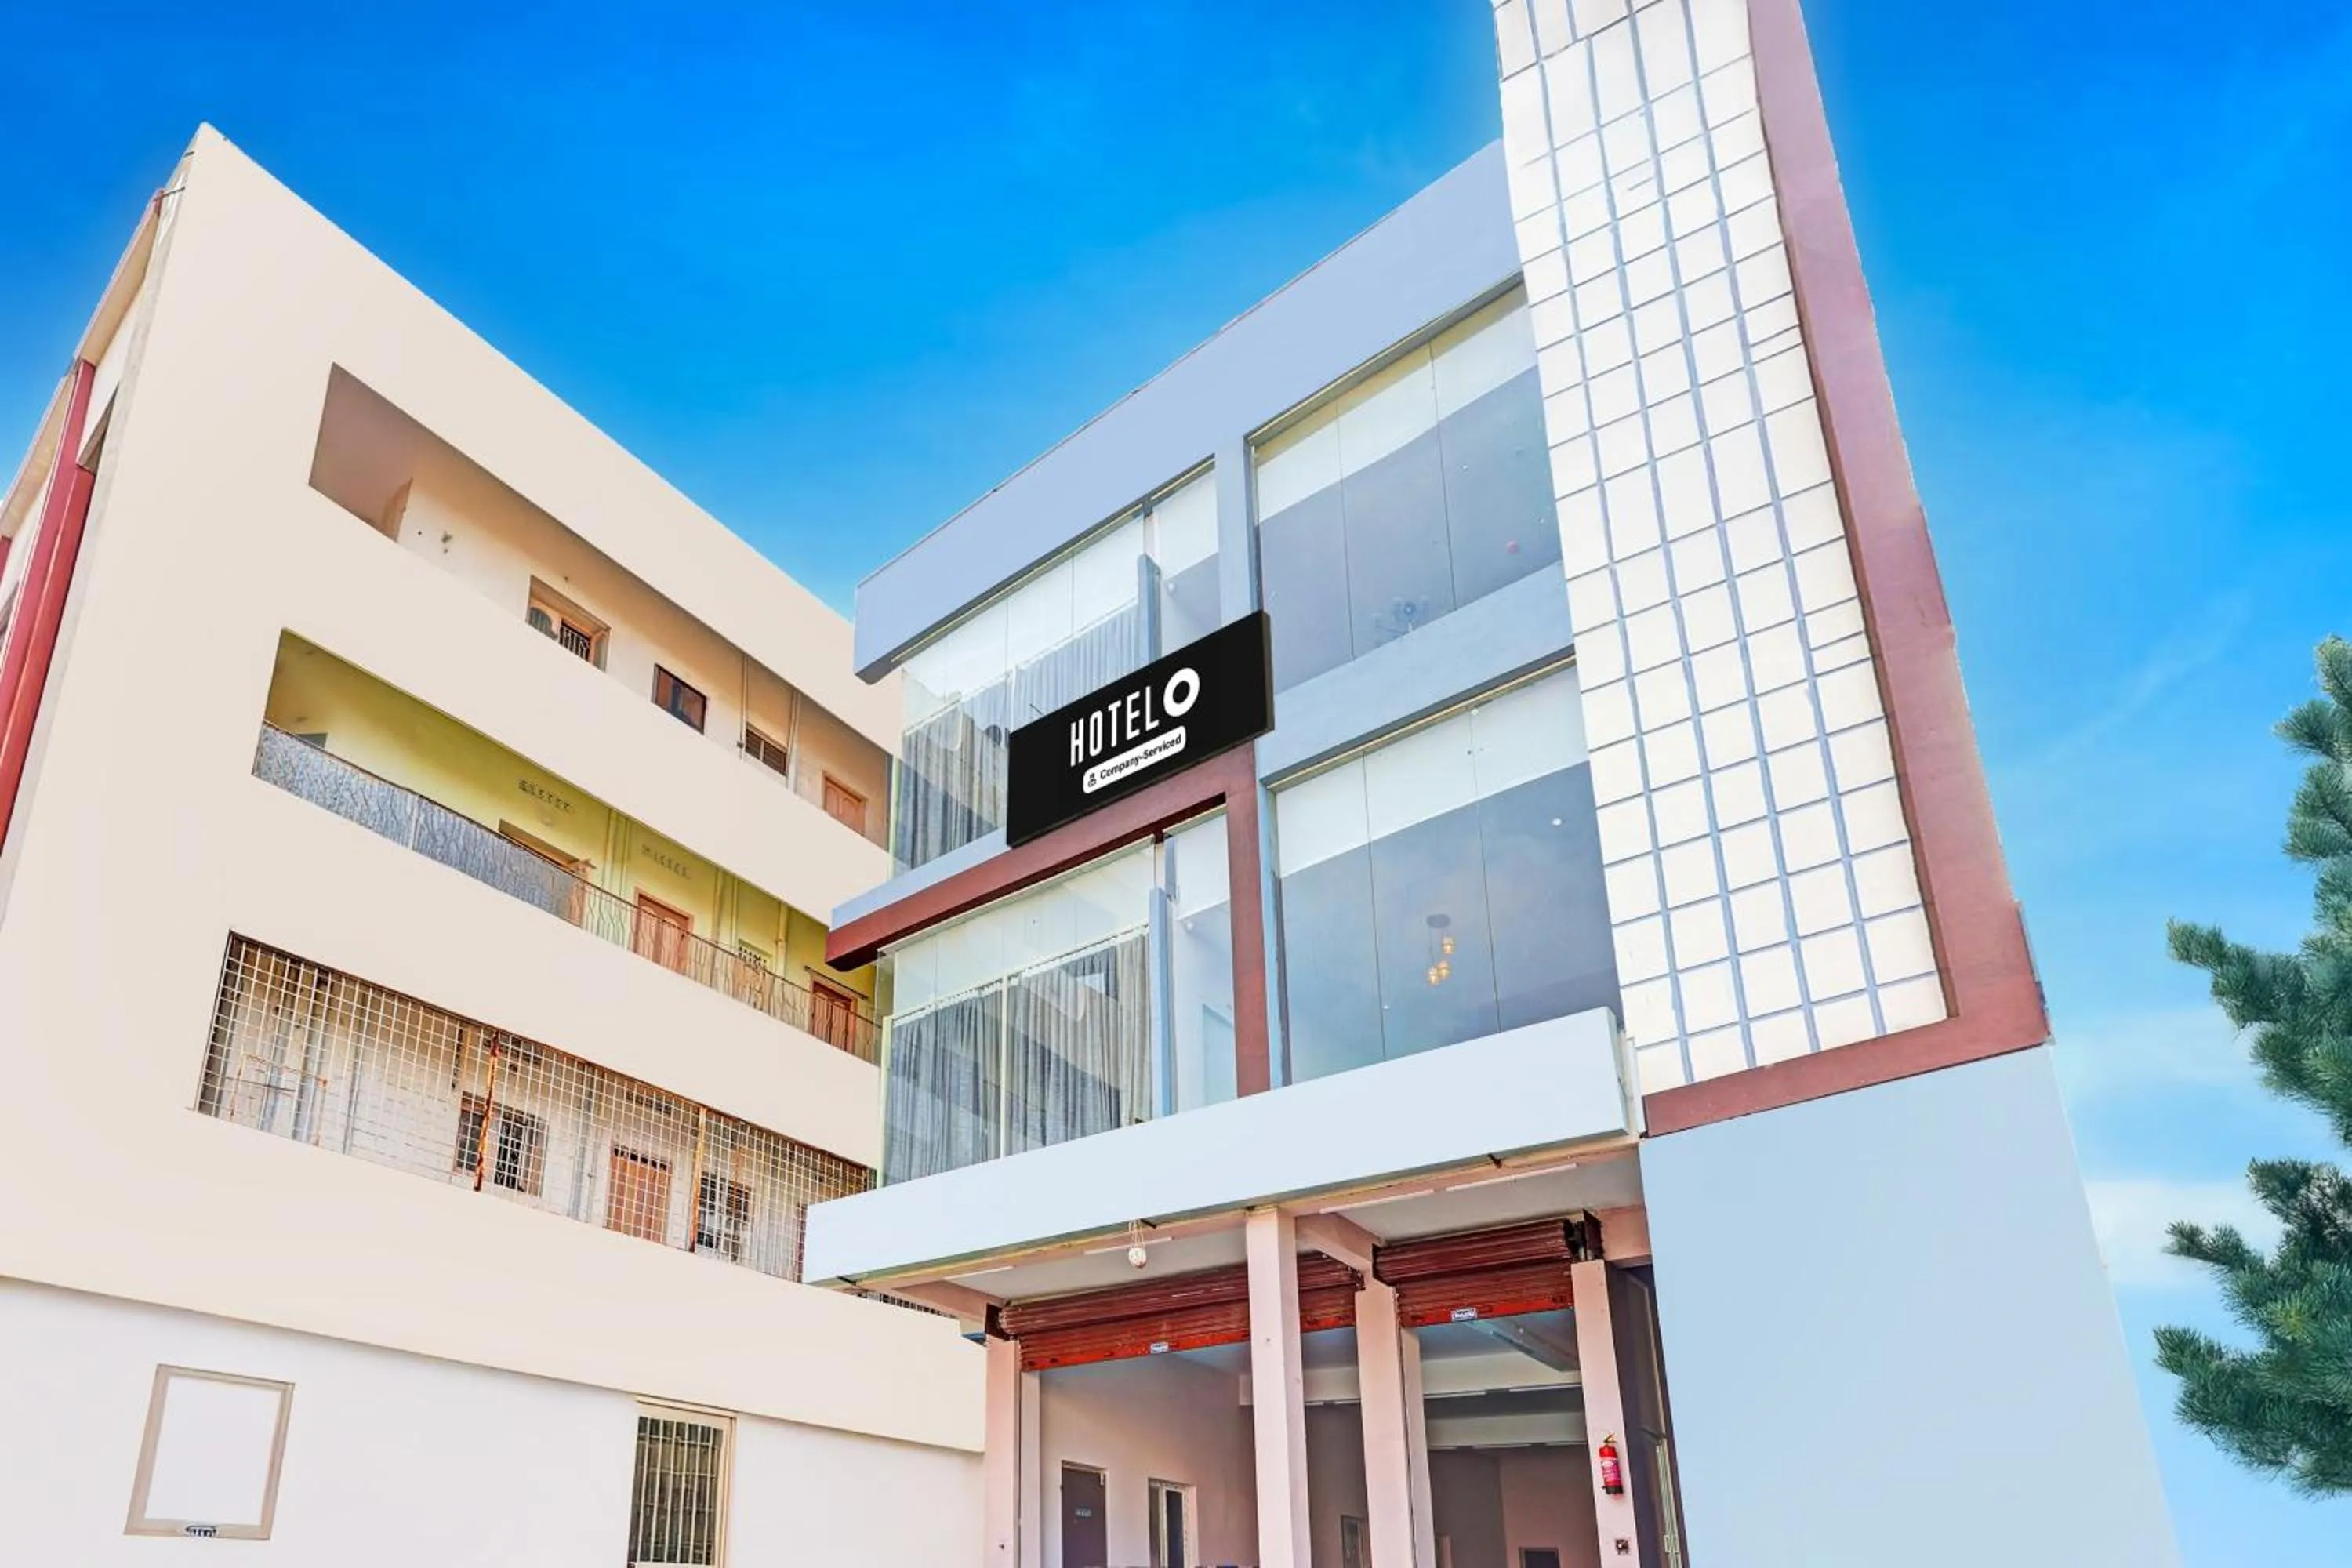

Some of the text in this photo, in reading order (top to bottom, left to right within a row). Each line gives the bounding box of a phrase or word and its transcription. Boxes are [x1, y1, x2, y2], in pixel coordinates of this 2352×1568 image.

[1069, 667, 1200, 767] HOTEL O
[1100, 733, 1181, 780] Company-Serviced
